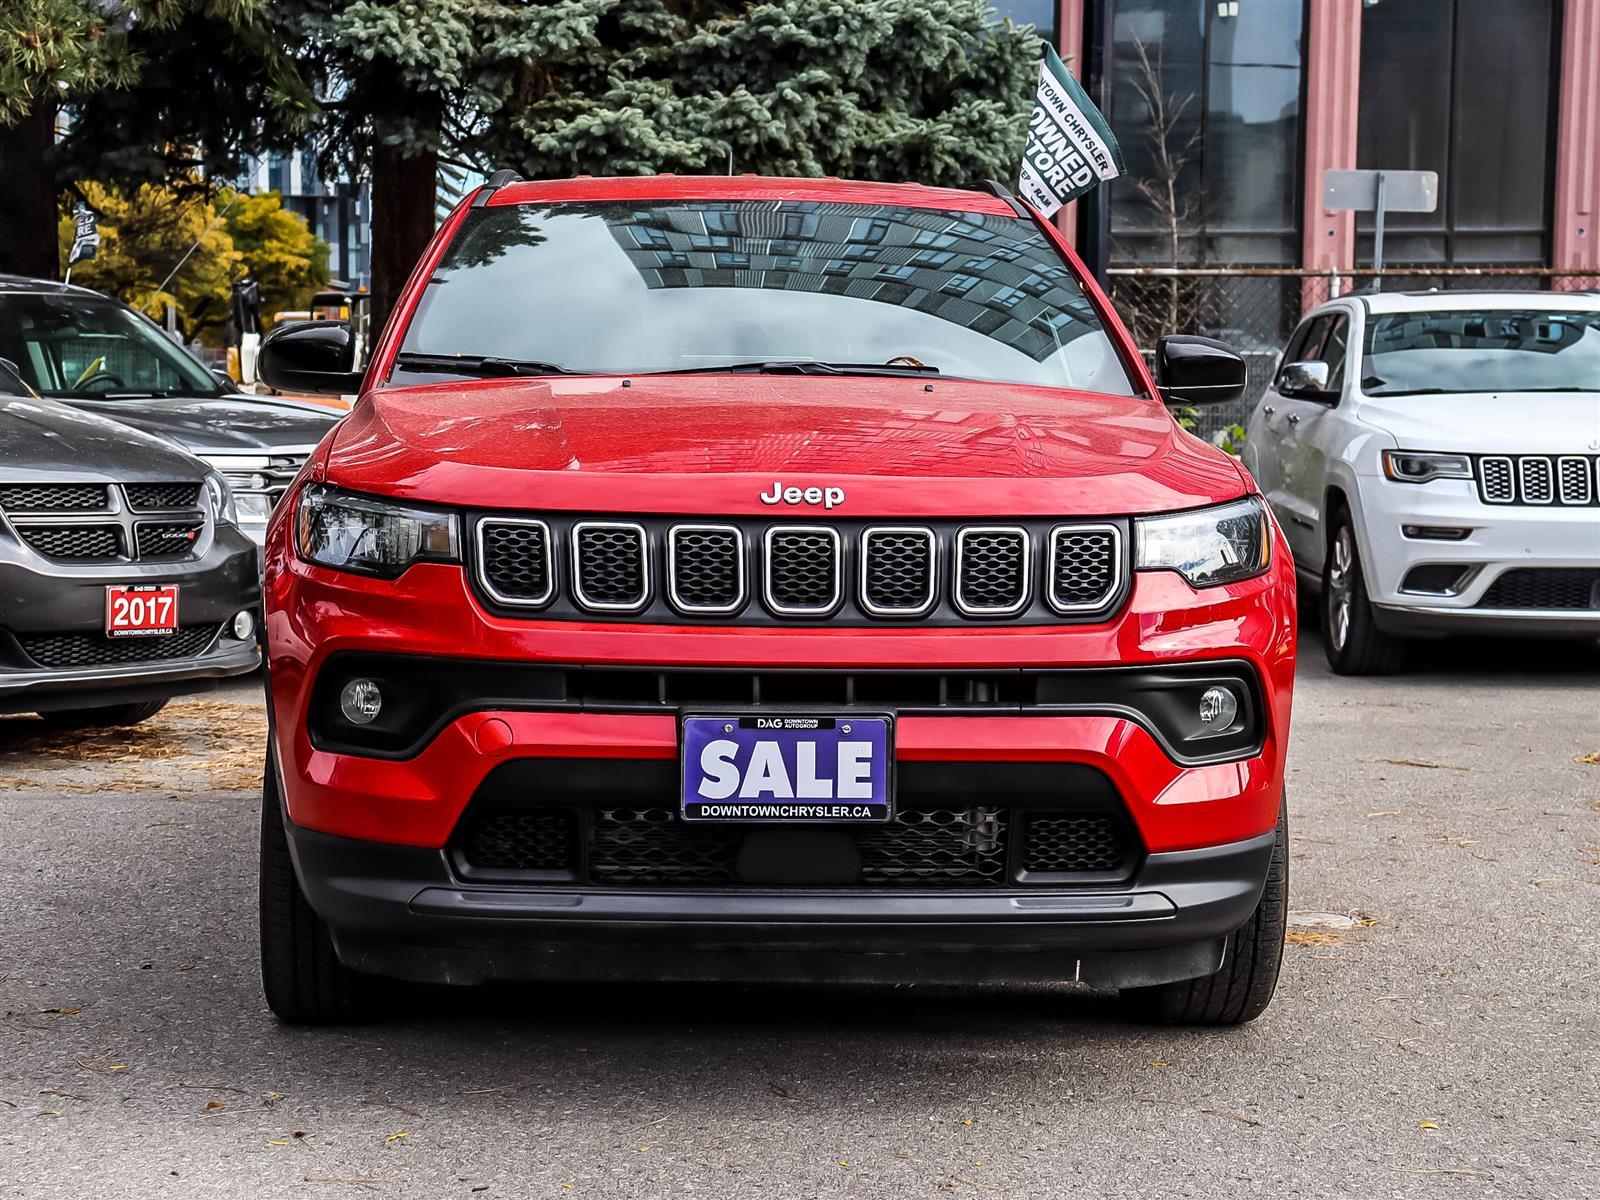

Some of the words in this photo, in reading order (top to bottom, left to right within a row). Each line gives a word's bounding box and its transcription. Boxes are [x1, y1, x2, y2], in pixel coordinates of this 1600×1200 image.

[1029, 106, 1092, 188] OWNED
[1064, 113, 1109, 172] CHRYSLER
[1033, 187, 1052, 207] RAM
[760, 480, 845, 509] Jeep
[114, 597, 173, 626] 2017
[757, 718, 783, 728] DAG
[697, 739, 873, 799] SALE
[701, 805, 872, 818] DOWNTOWNCHRYSLER.CA
